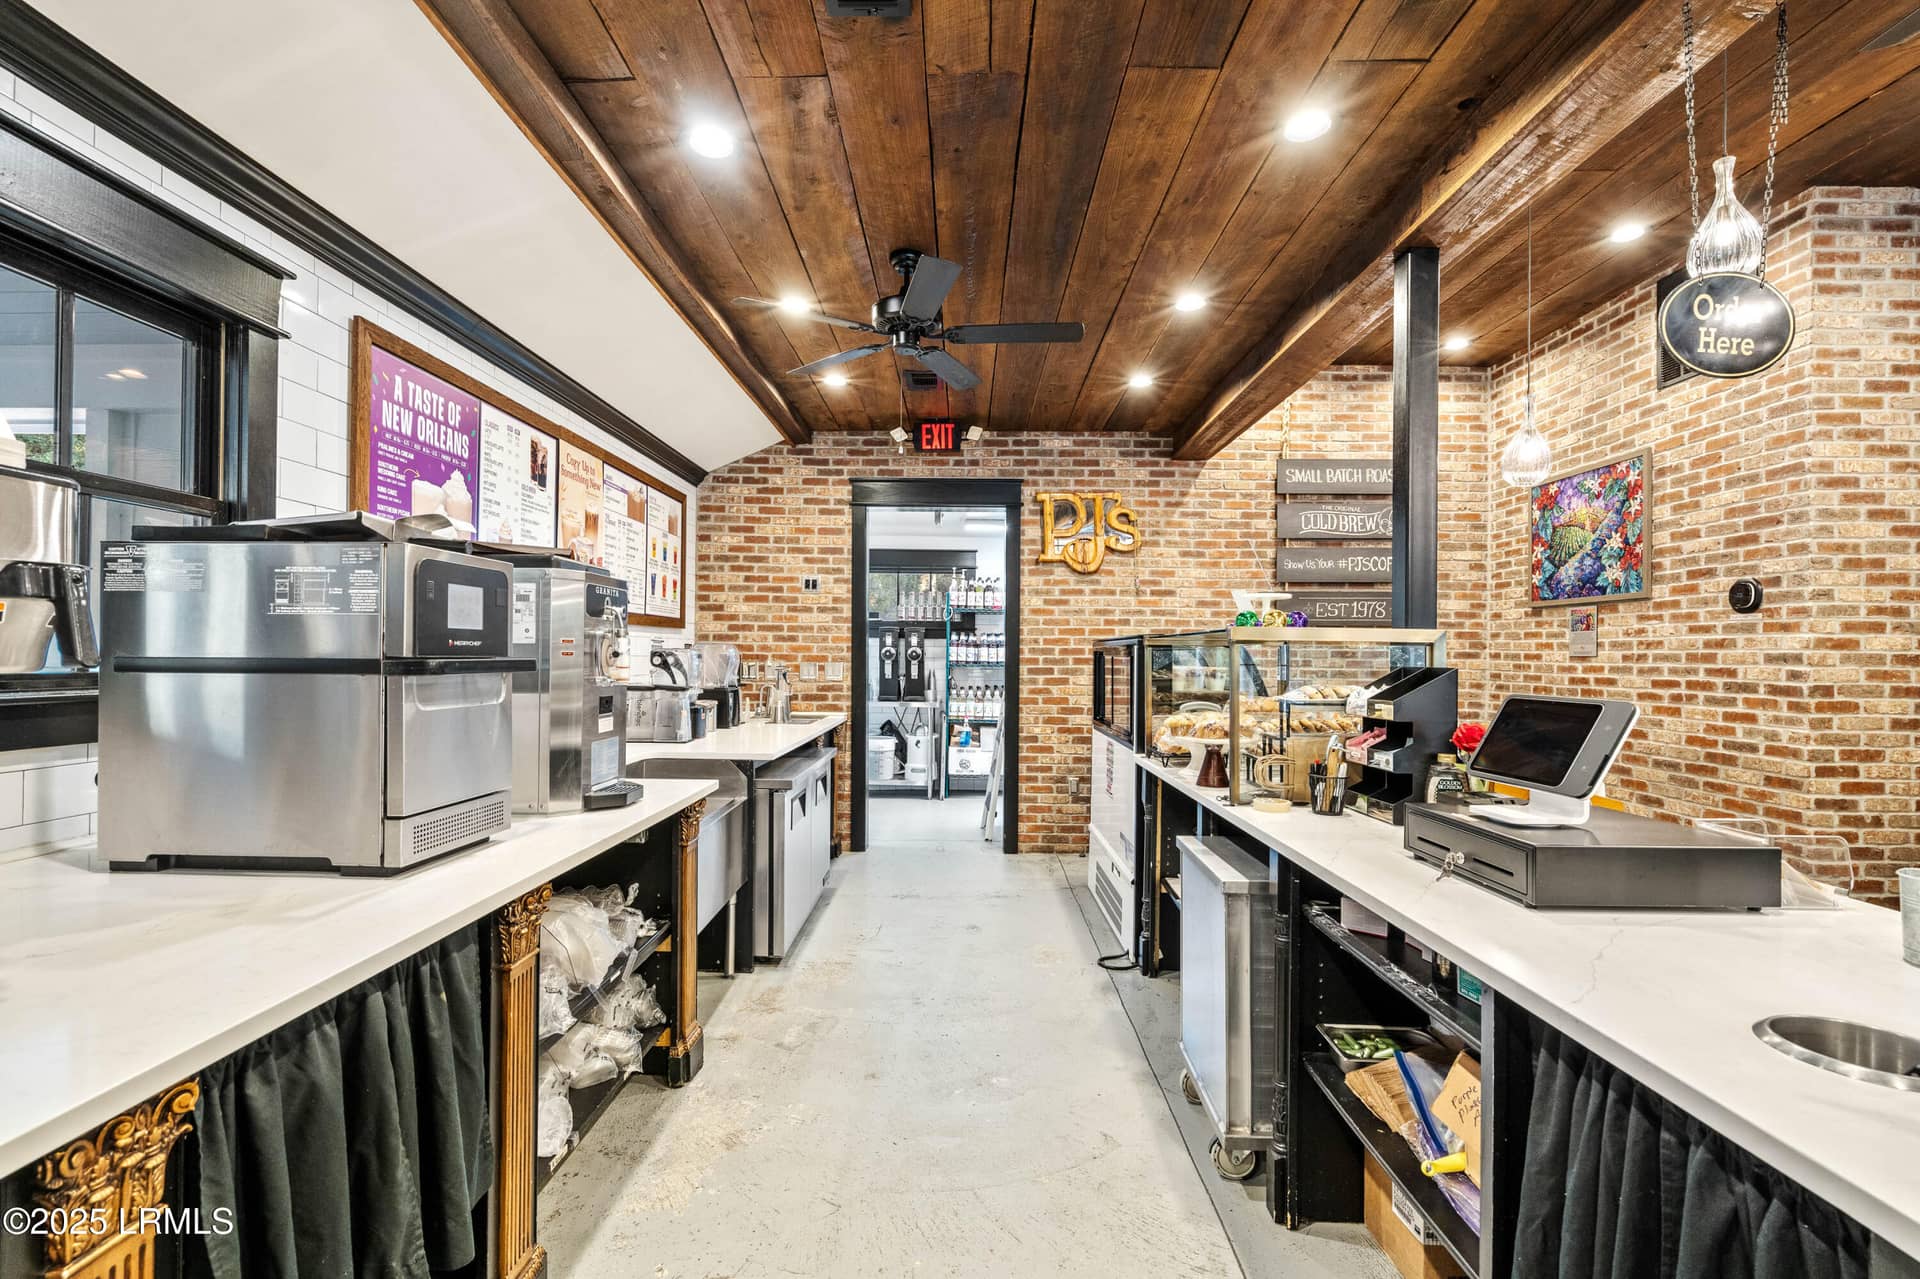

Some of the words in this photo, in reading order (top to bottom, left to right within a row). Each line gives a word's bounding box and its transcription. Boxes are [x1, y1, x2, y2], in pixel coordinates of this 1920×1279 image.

[1693, 293, 1755, 321] Ord
[1697, 327, 1755, 356] Here
[393, 374, 403, 404] A
[407, 380, 445, 422] TASTE
[447, 400, 461, 429] OF
[382, 400, 413, 437] NEW
[417, 415, 469, 459] ORLEANS
[921, 423, 955, 450] EXIT
[1286, 468, 1322, 483] SMALL
[1326, 468, 1362, 483] BATCH
[1302, 514, 1337, 530] COLD
[1340, 514, 1378, 532] BREW
[1284, 559, 1305, 570] Show
[1306, 559, 1316, 569] Us
[595, 586, 619, 598] GRANITA
[1316, 602, 1349, 618] EST
[1352, 601, 1386, 618] 1978
